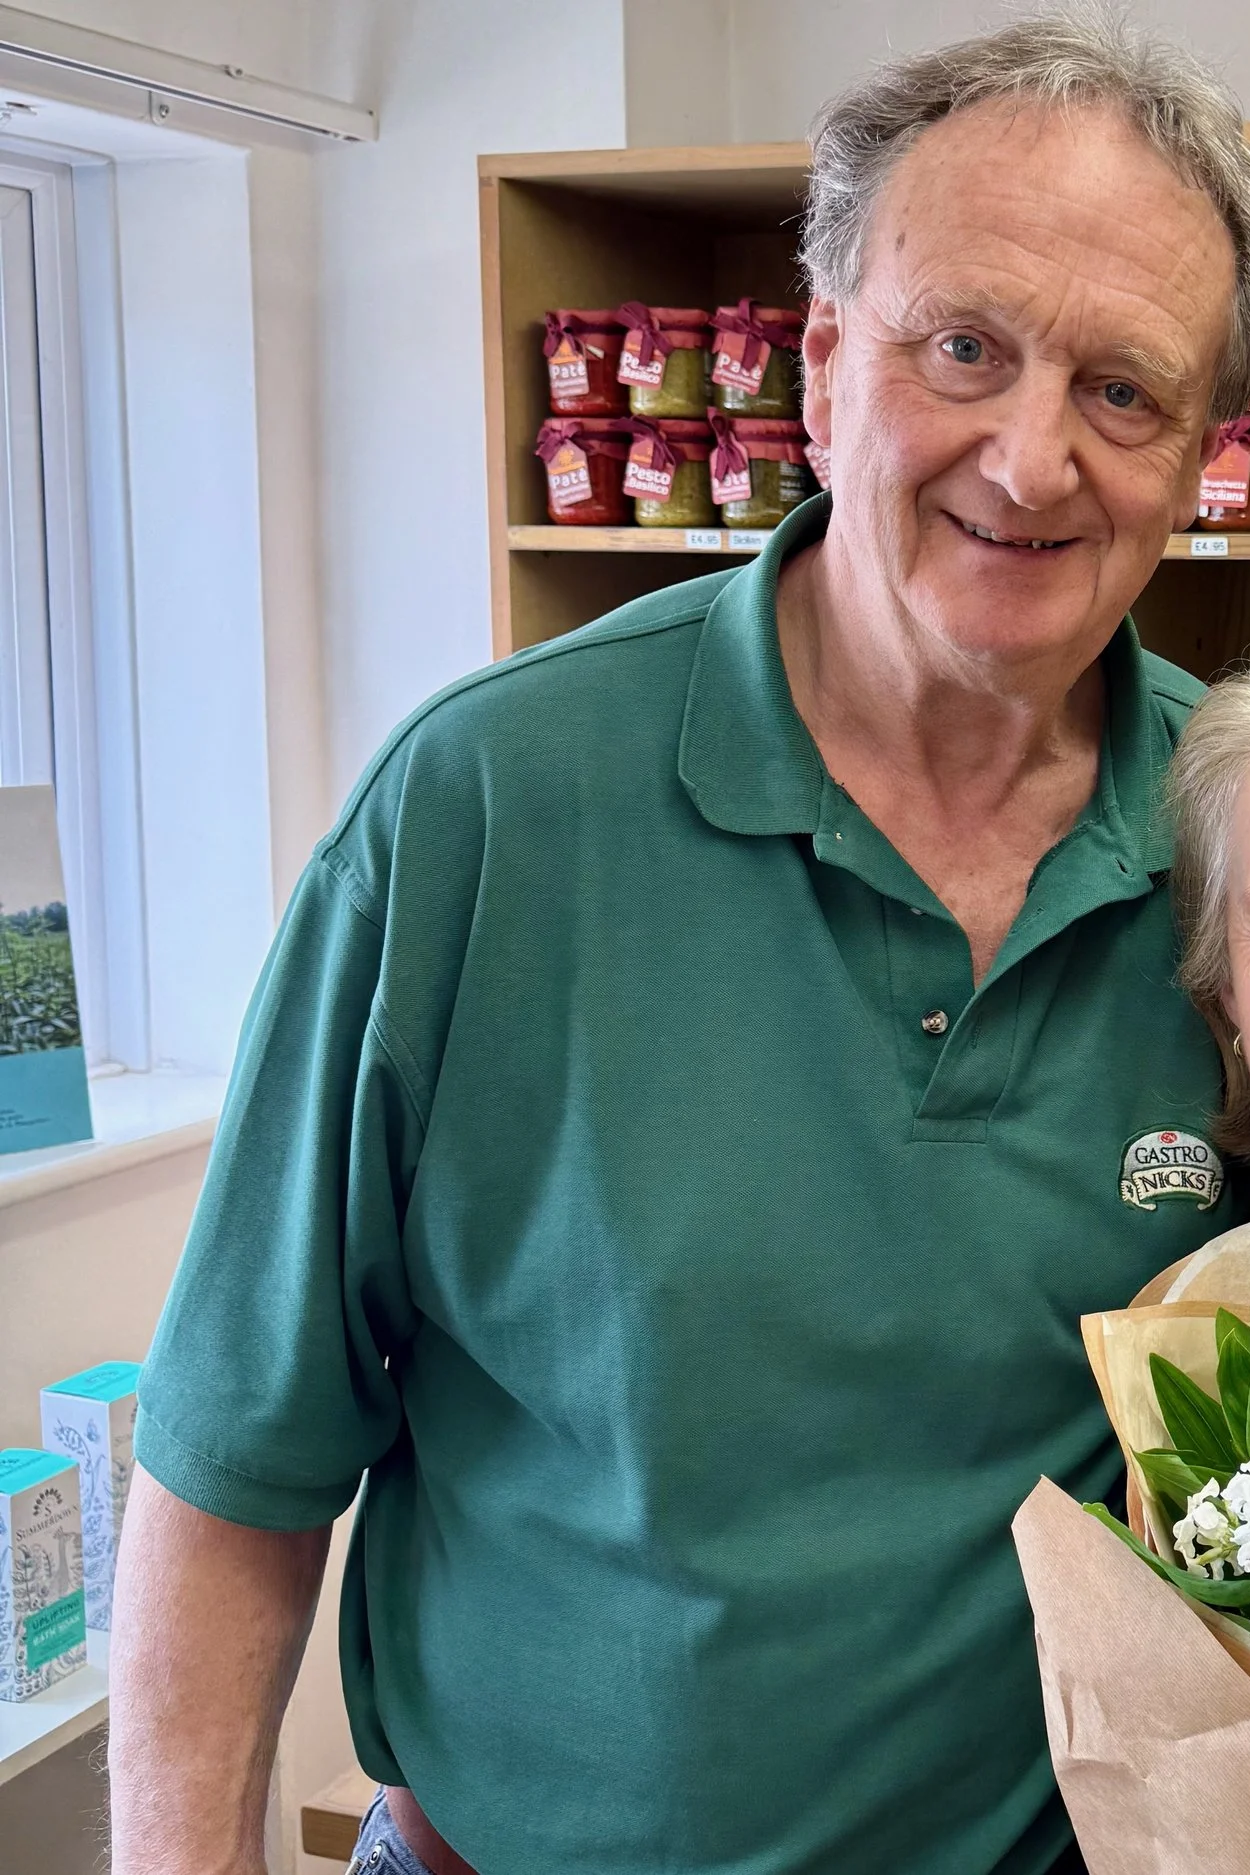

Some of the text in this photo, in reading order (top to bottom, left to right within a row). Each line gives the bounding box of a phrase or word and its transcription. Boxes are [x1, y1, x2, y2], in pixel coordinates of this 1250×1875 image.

[627, 462, 671, 485] Pesto
[1195, 542, 1226, 552] £4.95
[1135, 1145, 1208, 1164] GASTRO
[1138, 1170, 1207, 1193] NICKS
